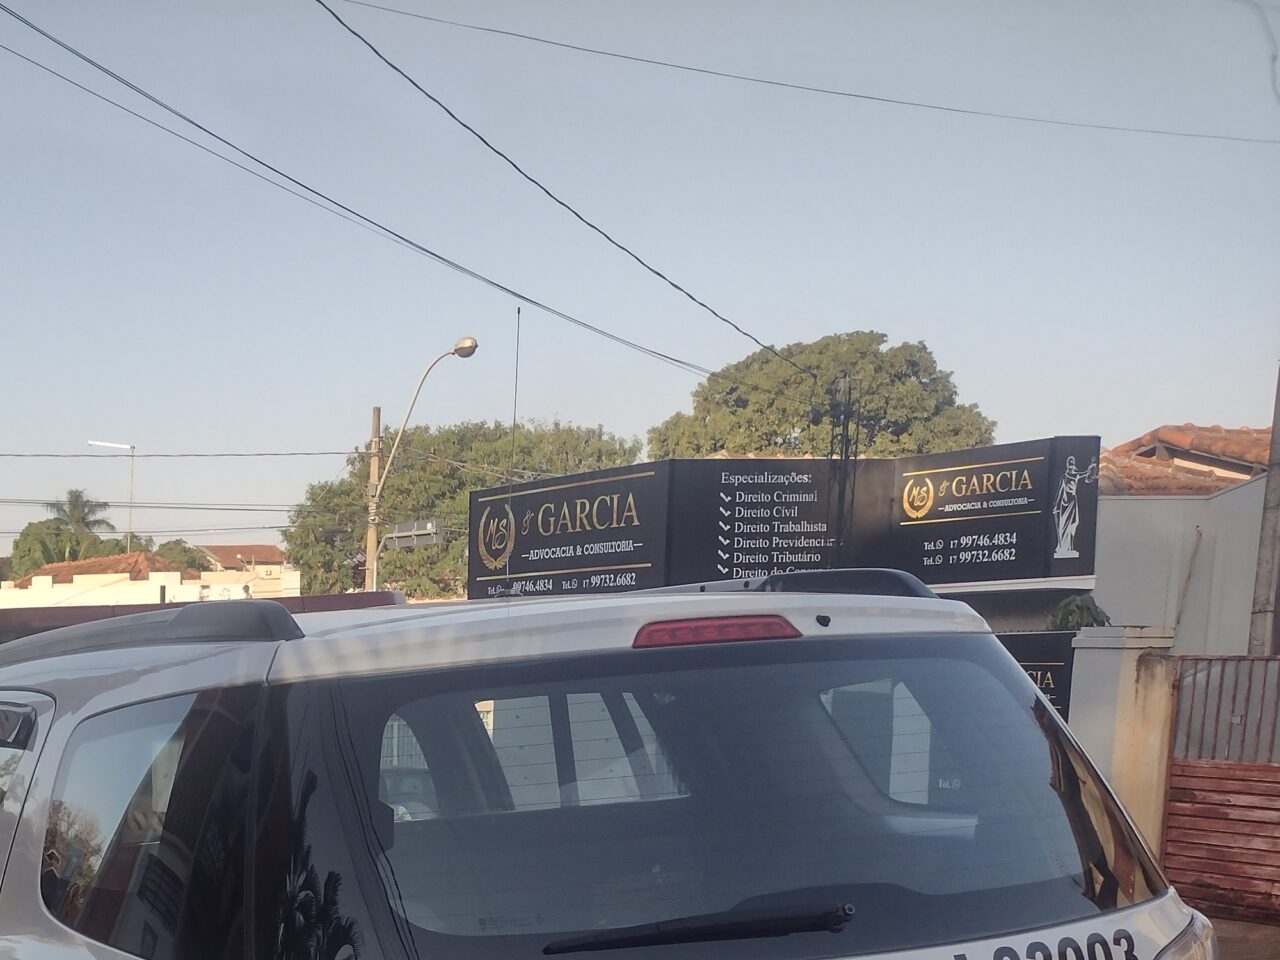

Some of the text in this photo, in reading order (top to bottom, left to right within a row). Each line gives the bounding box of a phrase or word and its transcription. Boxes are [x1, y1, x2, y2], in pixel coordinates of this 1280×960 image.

[721, 472, 812, 486] Especializações:
[952, 469, 1033, 497] GARCIA
[736, 490, 818, 502] Direito Criminal
[944, 502, 981, 512] ADVOCACIA
[988, 497, 1028, 508] CONSULTORIA
[537, 492, 640, 536] GARCIA
[735, 506, 770, 518] Direito
[734, 520, 827, 533] Direito Trabalhista
[734, 537, 769, 548] Direito
[950, 540, 958, 549] 17
[960, 532, 1017, 548] 99746.4834
[528, 540, 634, 561] ADVOCACIA & CONSULTORIA
[733, 551, 821, 563] Direito Tributário
[949, 556, 958, 564] 17
[959, 548, 1016, 564] 99732.6682
[733, 567, 768, 578] Direito
[583, 580, 590, 588] 17
[590, 572, 636, 587] 99732.6682
